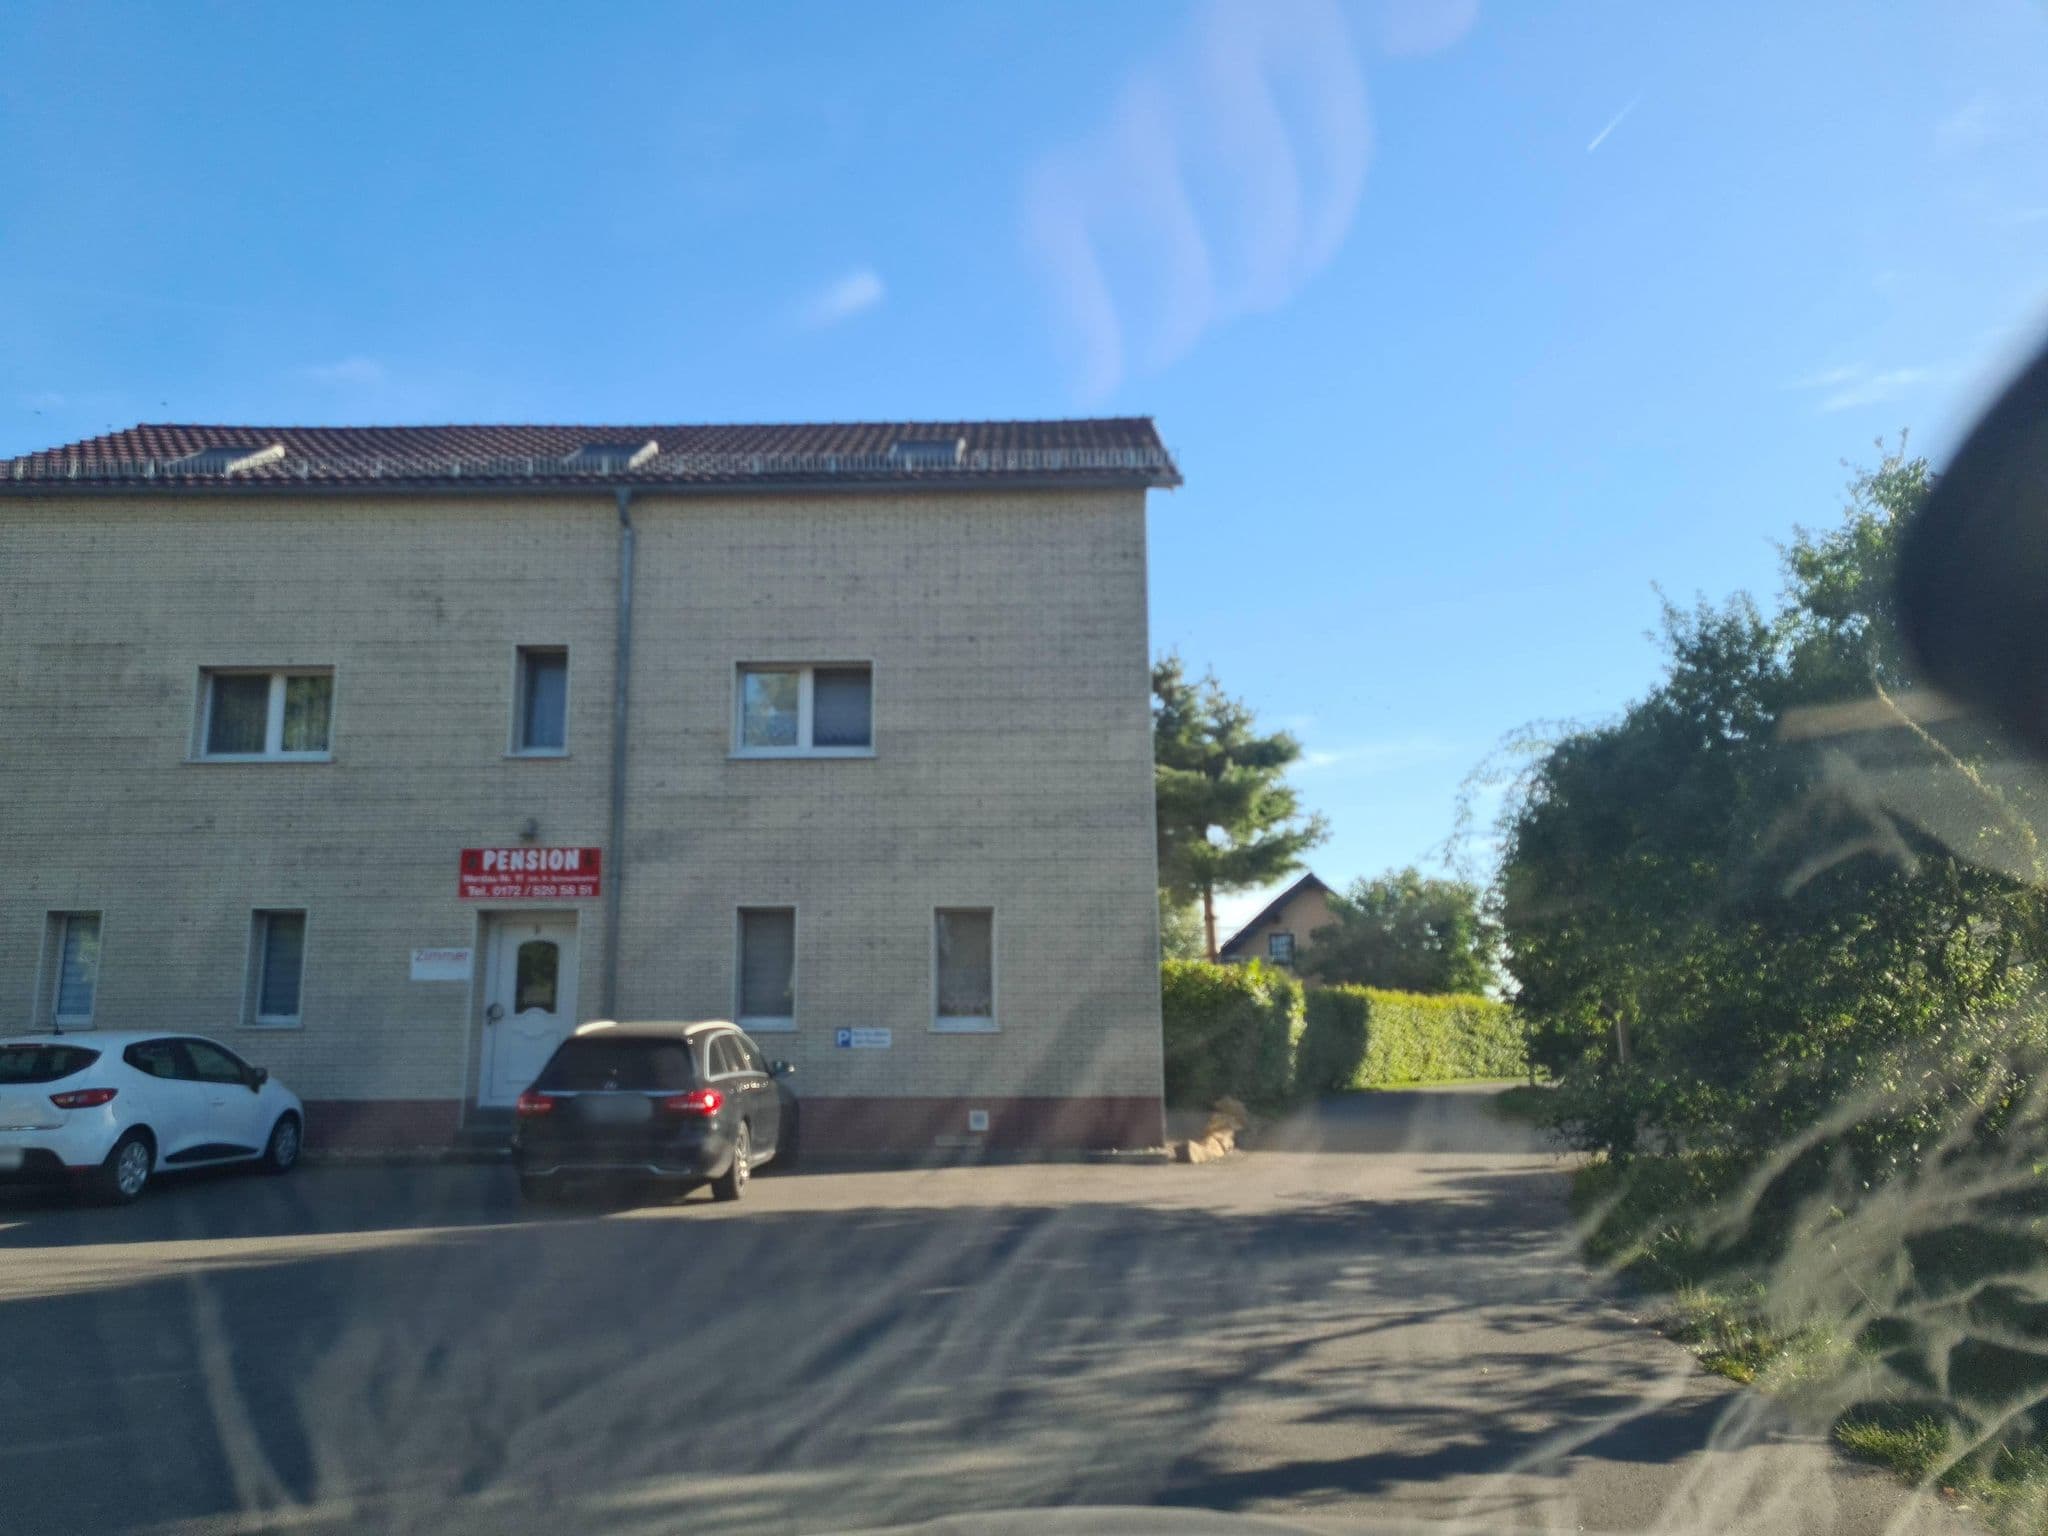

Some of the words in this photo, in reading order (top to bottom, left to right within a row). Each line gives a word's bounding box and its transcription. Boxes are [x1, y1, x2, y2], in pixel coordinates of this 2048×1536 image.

[483, 849, 580, 871] PENSION
[468, 885, 490, 896] Tel.
[492, 885, 521, 896] 0172
[415, 950, 468, 961] Zimmer
